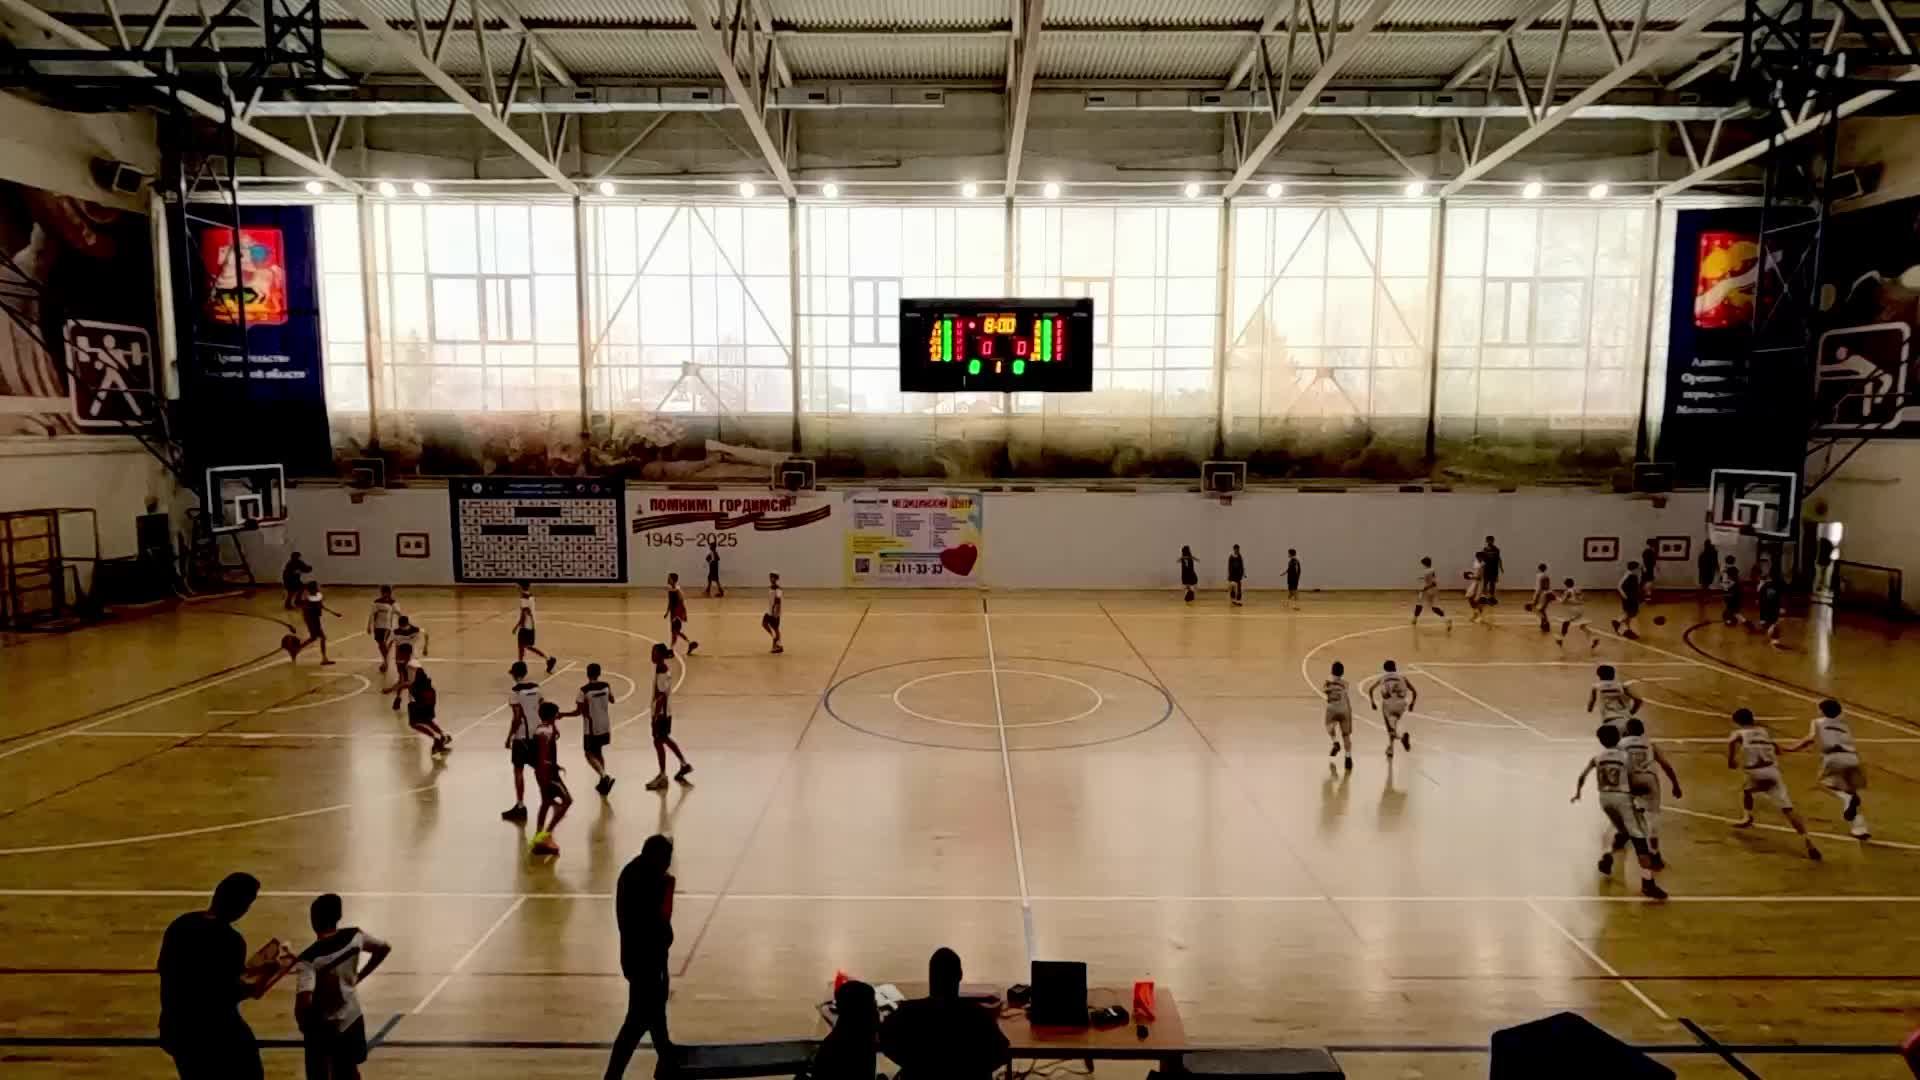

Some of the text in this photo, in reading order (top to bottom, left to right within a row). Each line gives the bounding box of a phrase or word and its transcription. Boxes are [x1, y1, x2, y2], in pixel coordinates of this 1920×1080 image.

[649, 497, 793, 513] ПОМНИМ! ГОРДИМСЯ!
[894, 563, 944, 575] 411-33-33
